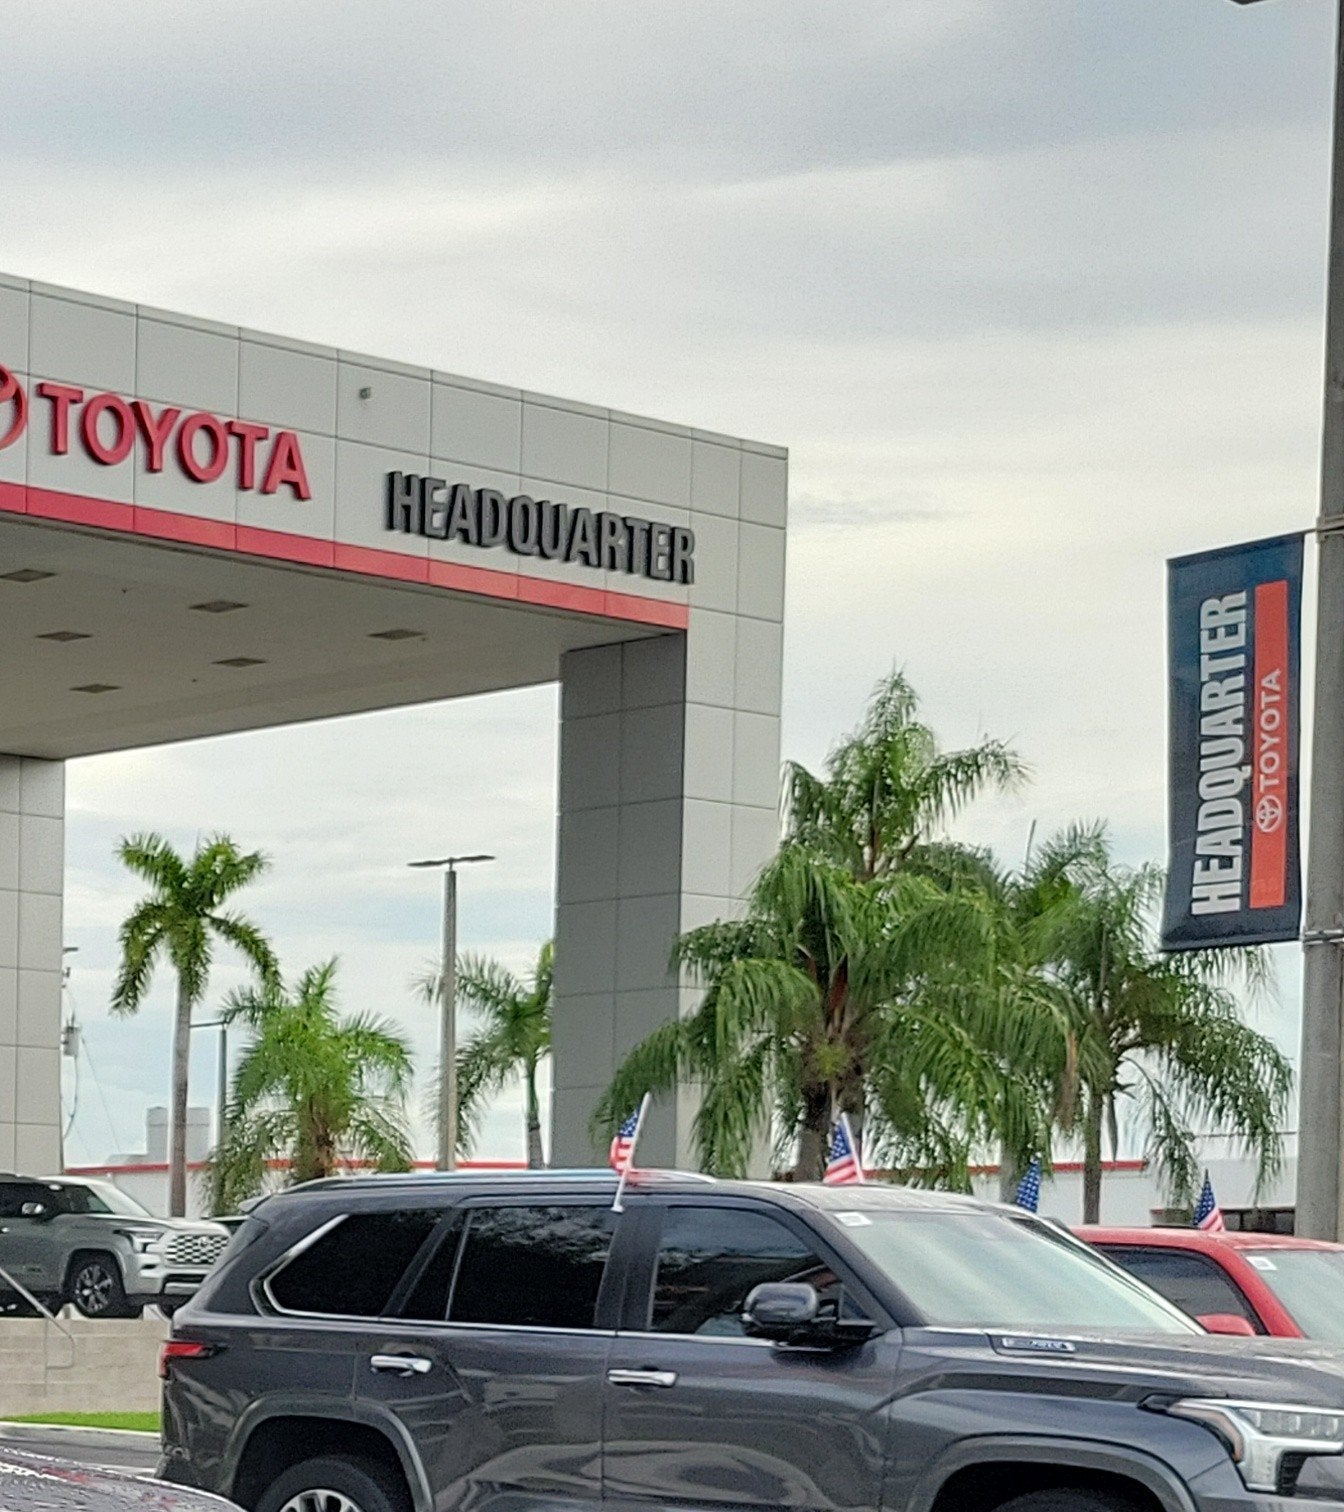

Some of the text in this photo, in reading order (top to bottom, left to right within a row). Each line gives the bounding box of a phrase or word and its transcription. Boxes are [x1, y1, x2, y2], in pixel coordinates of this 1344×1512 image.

[36, 381, 312, 500] TOYOTA
[385, 470, 696, 585] HEADQUARTER
[1190, 589, 1251, 916] HEADQUARTER
[1258, 668, 1283, 793] TOYOTA
